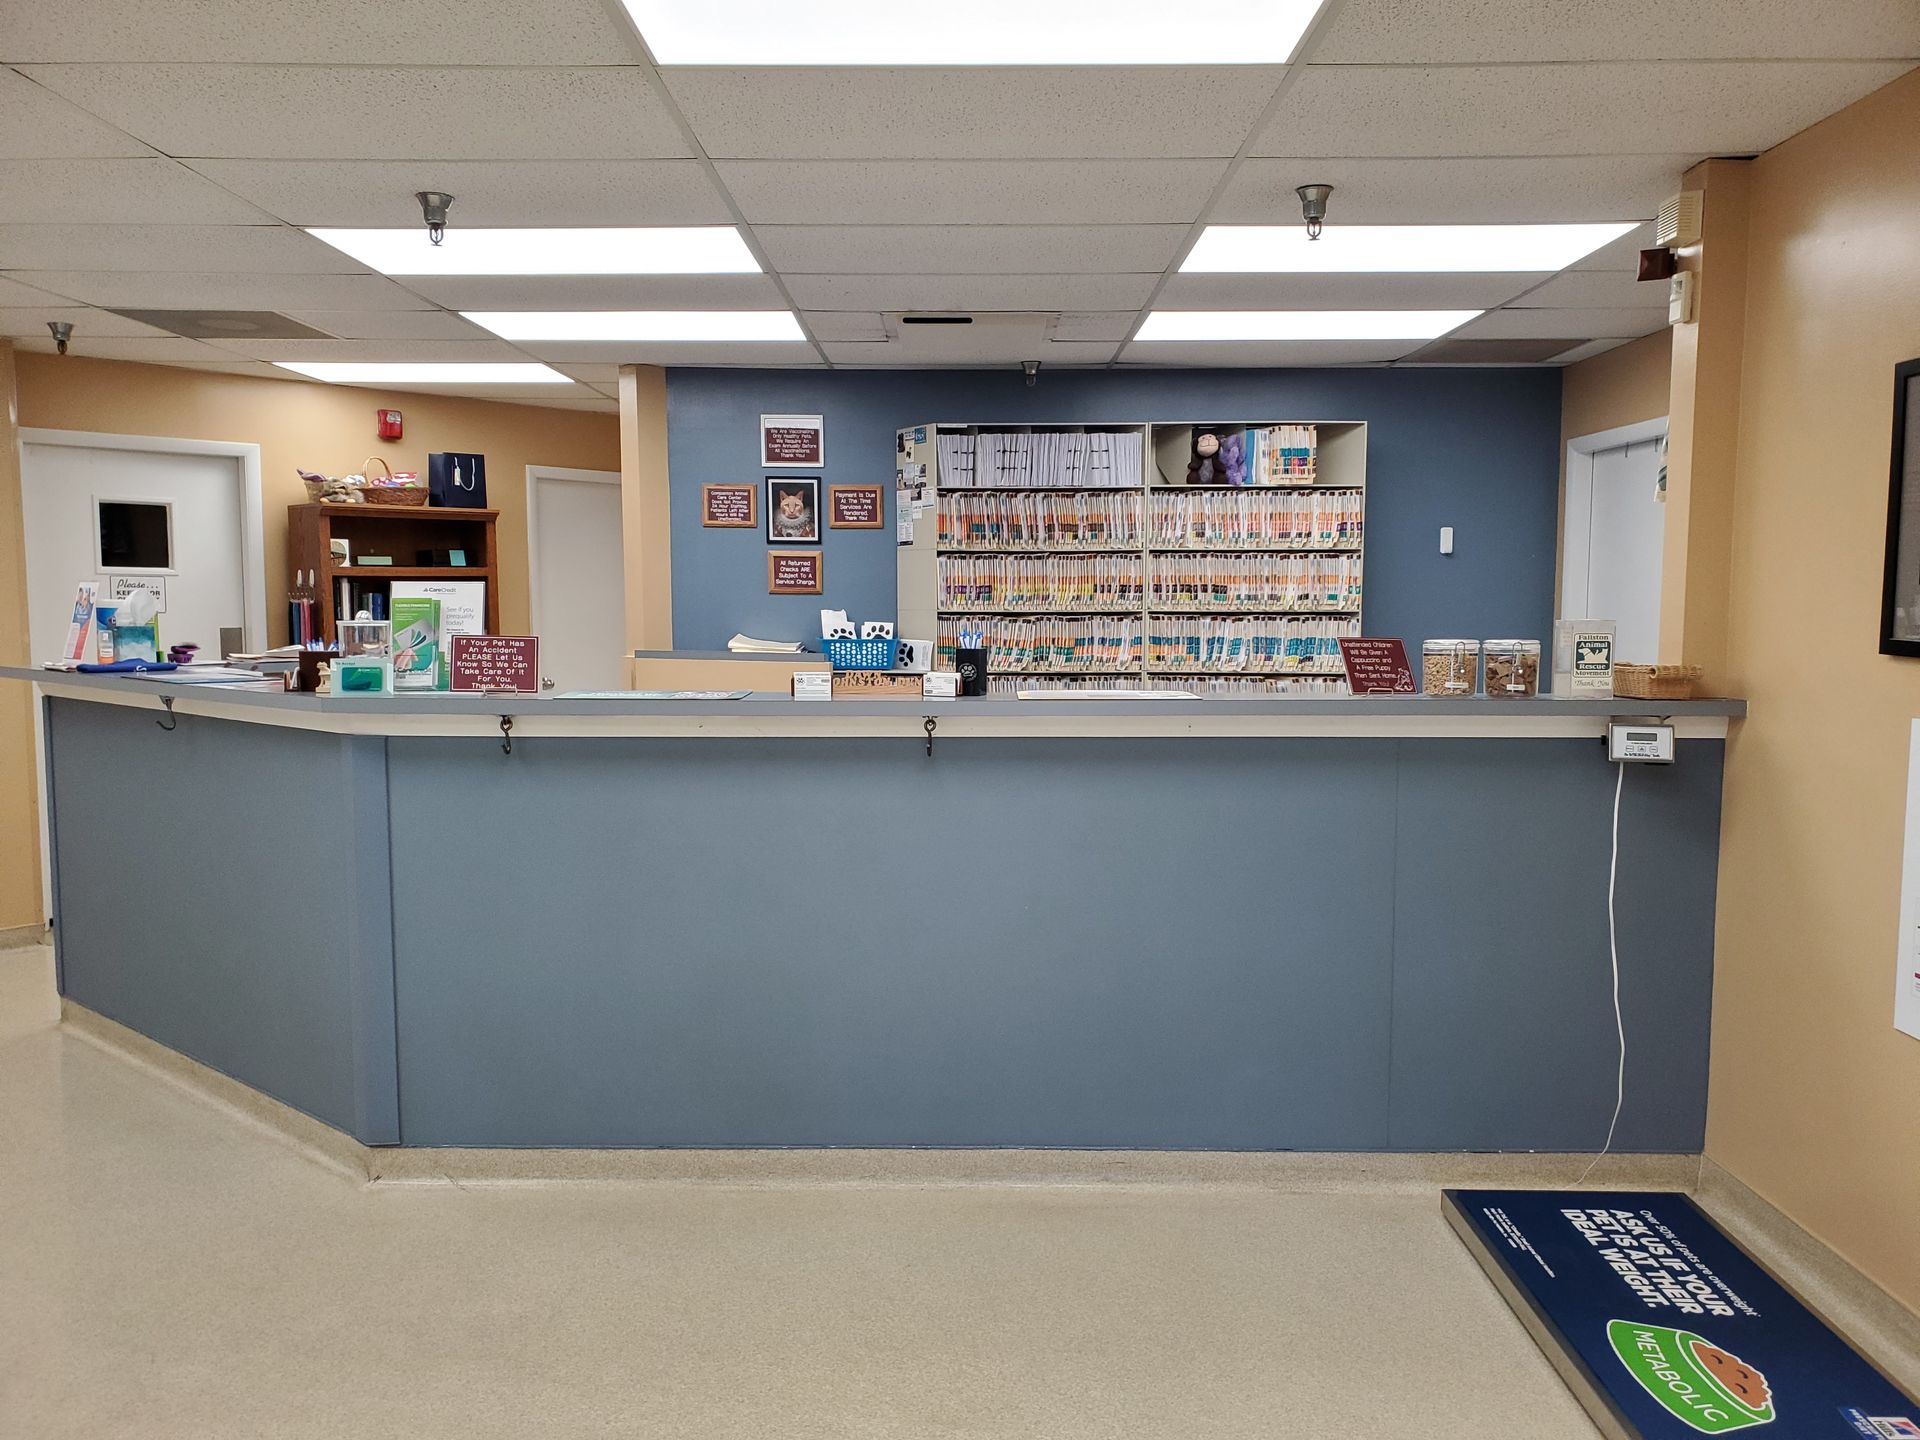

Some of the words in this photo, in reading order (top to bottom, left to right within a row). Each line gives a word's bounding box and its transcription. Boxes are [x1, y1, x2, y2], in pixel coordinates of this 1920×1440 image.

[1585, 1209, 1626, 1232] PET
[1640, 1210, 1660, 1225] Over
[1609, 1234, 1638, 1246] IS
[1655, 1225, 1677, 1239] 50%
[1671, 1239, 1687, 1248] of
[1560, 1209, 1610, 1246] IDEAL
[1598, 1248, 1671, 1307] WEIGHT.
[1609, 1209, 1654, 1236] ASK
[1640, 1238, 1673, 1255] US
[1658, 1258, 1691, 1272] IF
[1677, 1274, 1735, 1316] YOUR
[1623, 1248, 1660, 1267] AT
[1676, 1247, 1700, 1263] pets
[1695, 1263, 1713, 1275] are
[1646, 1270, 1705, 1314] THEIR
[1632, 1330, 1729, 1422] METABOLIC
